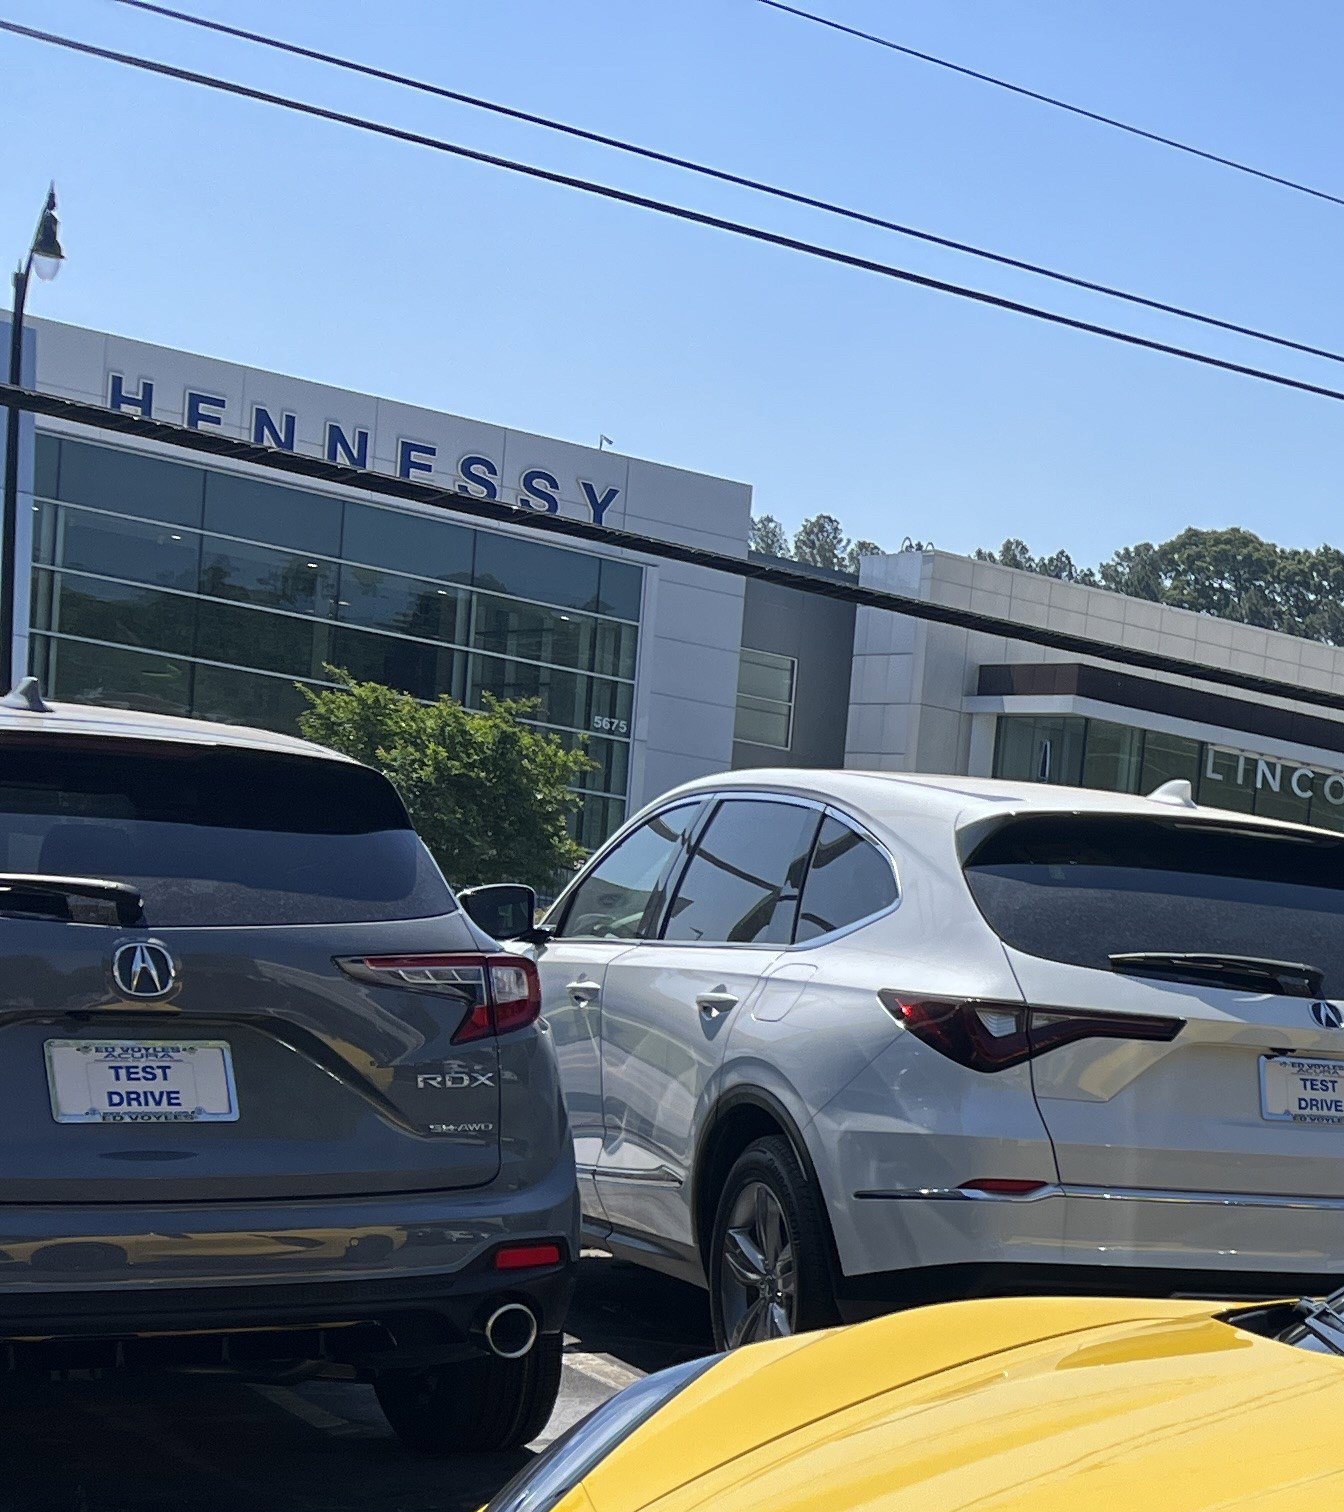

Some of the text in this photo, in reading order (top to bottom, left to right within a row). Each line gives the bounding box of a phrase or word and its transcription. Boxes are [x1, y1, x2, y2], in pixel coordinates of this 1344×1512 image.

[109, 373, 620, 526] HENNESSY
[593, 715, 628, 733] 5675
[108, 1065, 172, 1082] TEST
[417, 1072, 496, 1089] RDX
[1299, 1077, 1339, 1093] TEST
[106, 1090, 183, 1107] DRIVE
[1297, 1097, 1344, 1113] DRIVE
